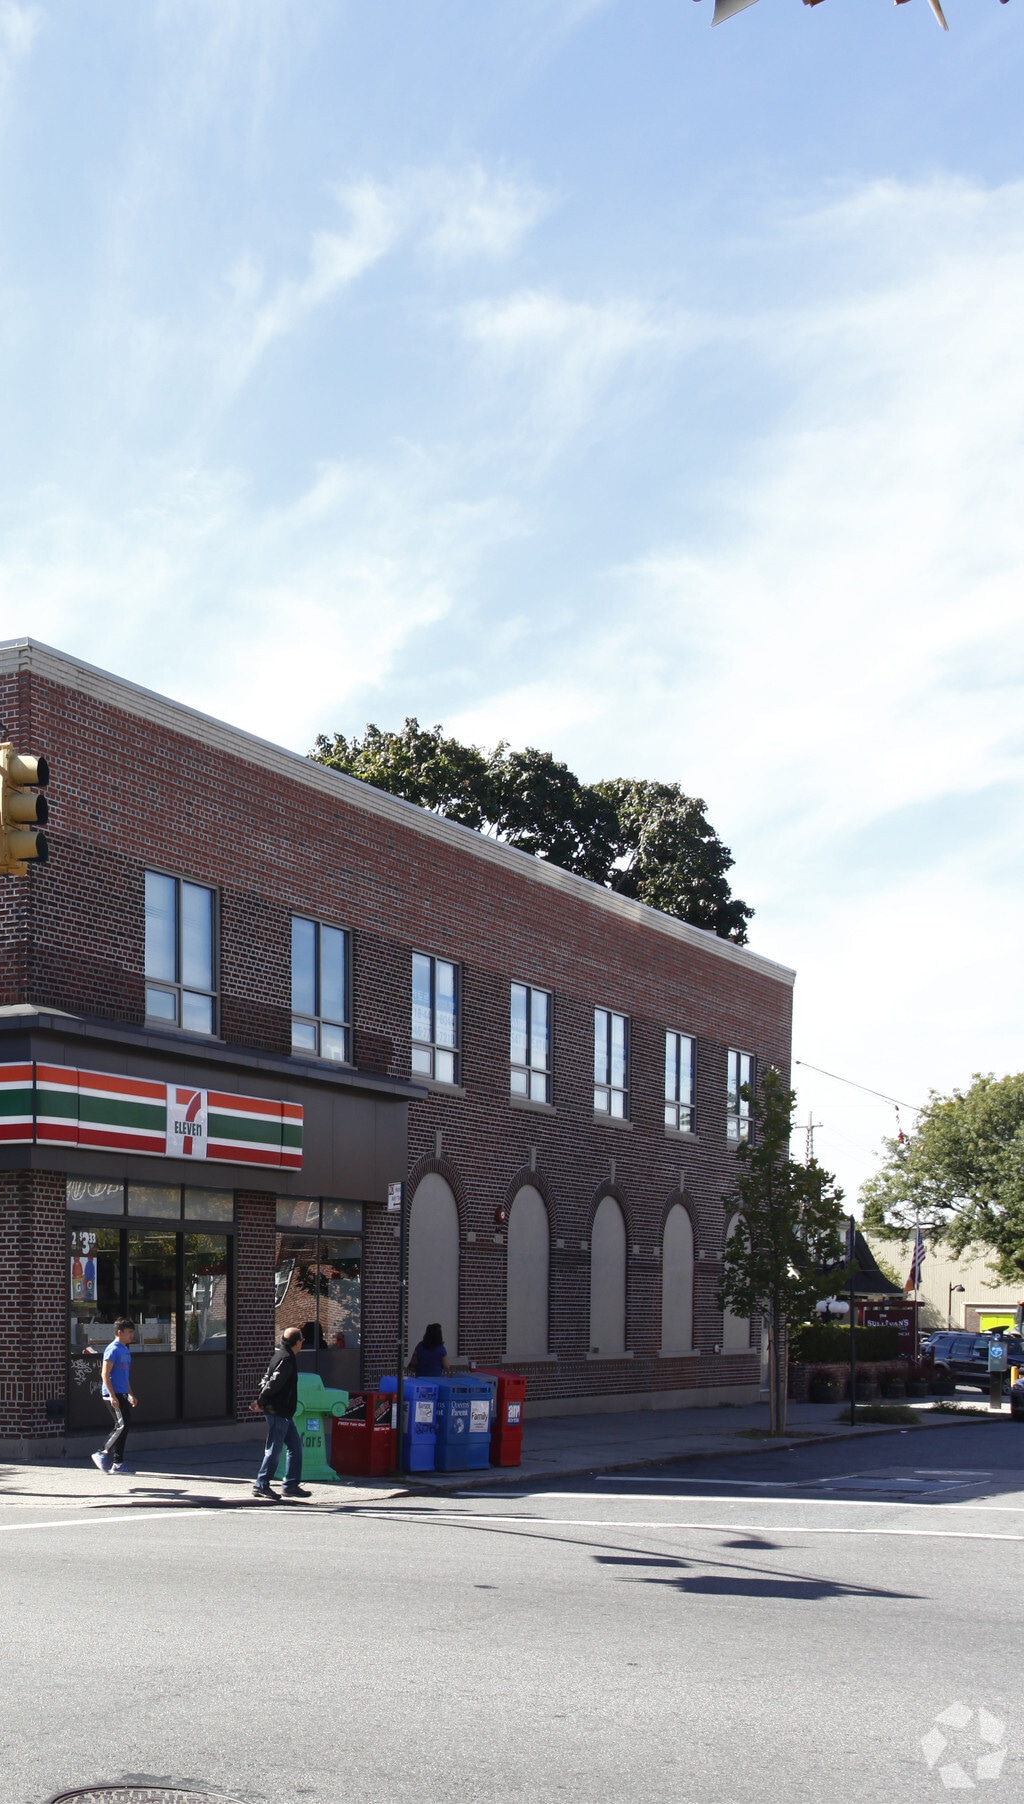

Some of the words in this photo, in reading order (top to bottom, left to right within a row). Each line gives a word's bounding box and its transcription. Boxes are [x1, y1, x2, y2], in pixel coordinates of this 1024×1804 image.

[71, 1232, 77, 1245] 2
[451, 1401, 469, 1409] Queens
[472, 1411, 488, 1422] Family
